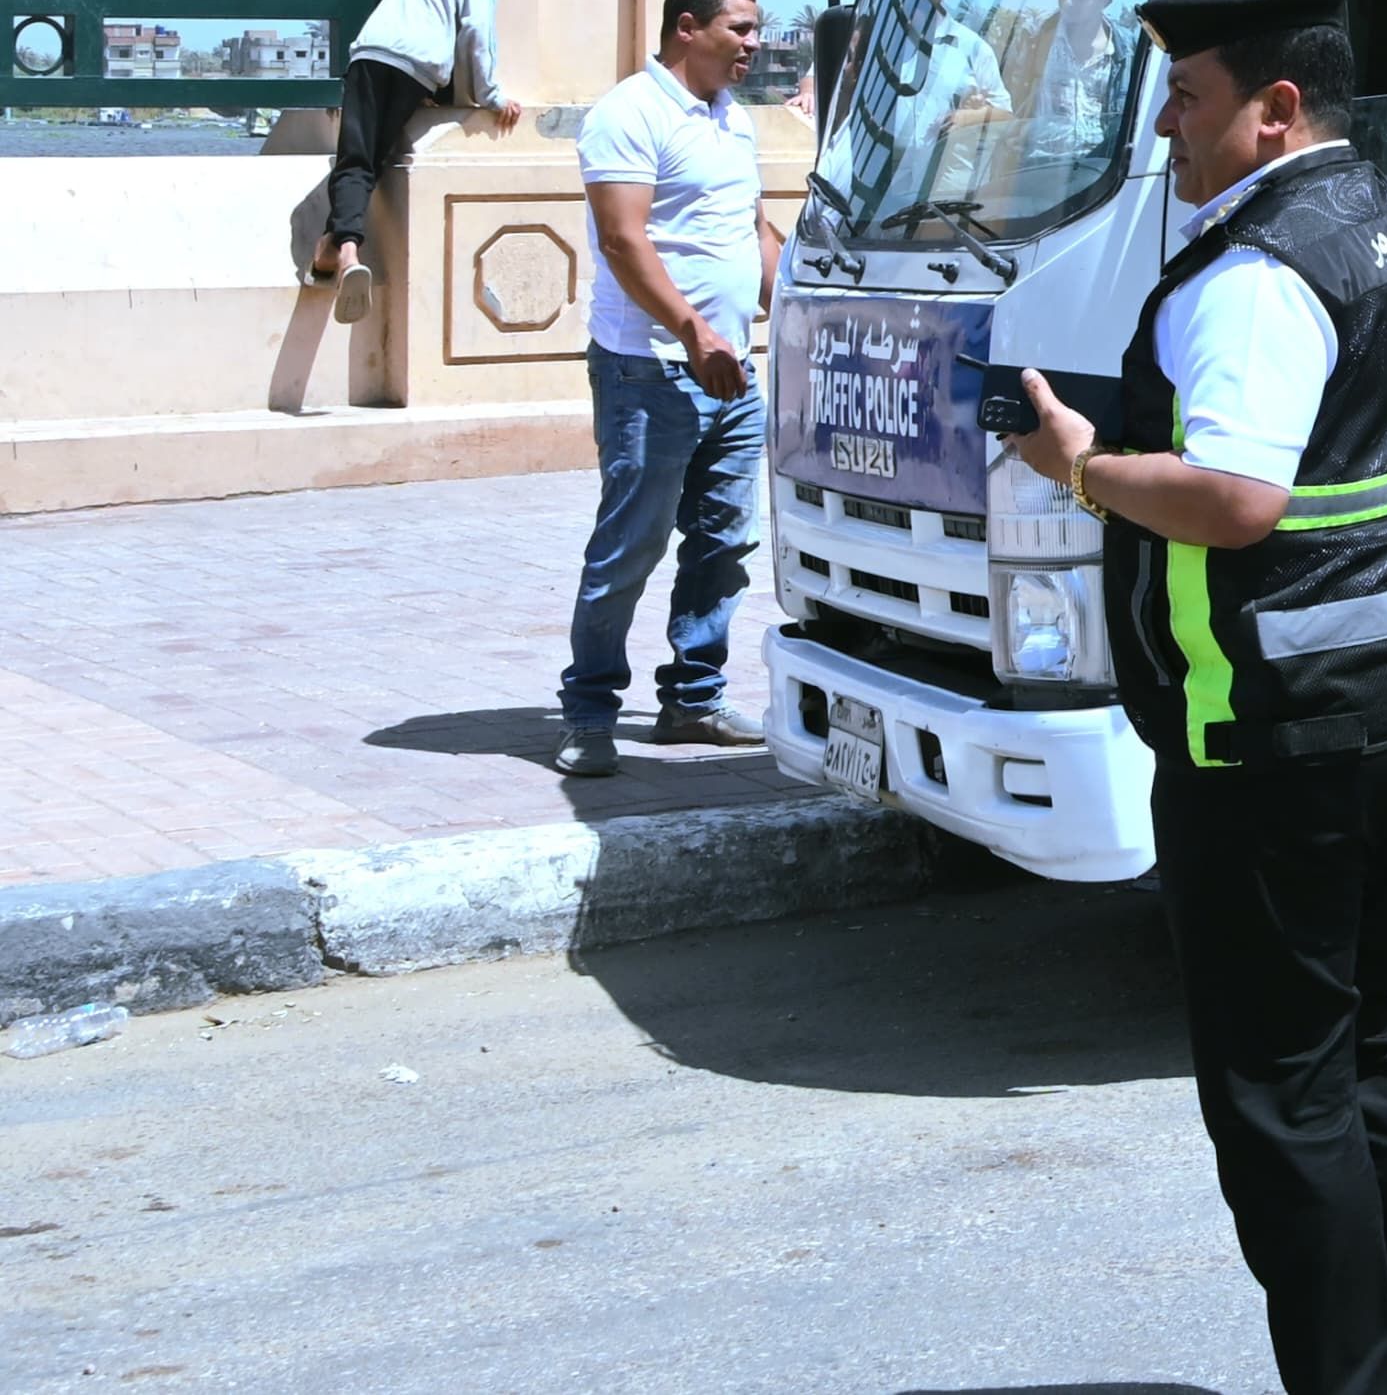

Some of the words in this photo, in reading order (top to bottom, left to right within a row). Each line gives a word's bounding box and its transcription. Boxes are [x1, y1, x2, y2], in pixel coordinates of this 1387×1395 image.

[808, 314, 858, 365] المرور
[808, 368, 861, 430] TRAFFIC
[865, 374, 919, 438] POLICE
[831, 432, 896, 479] ISUZU
